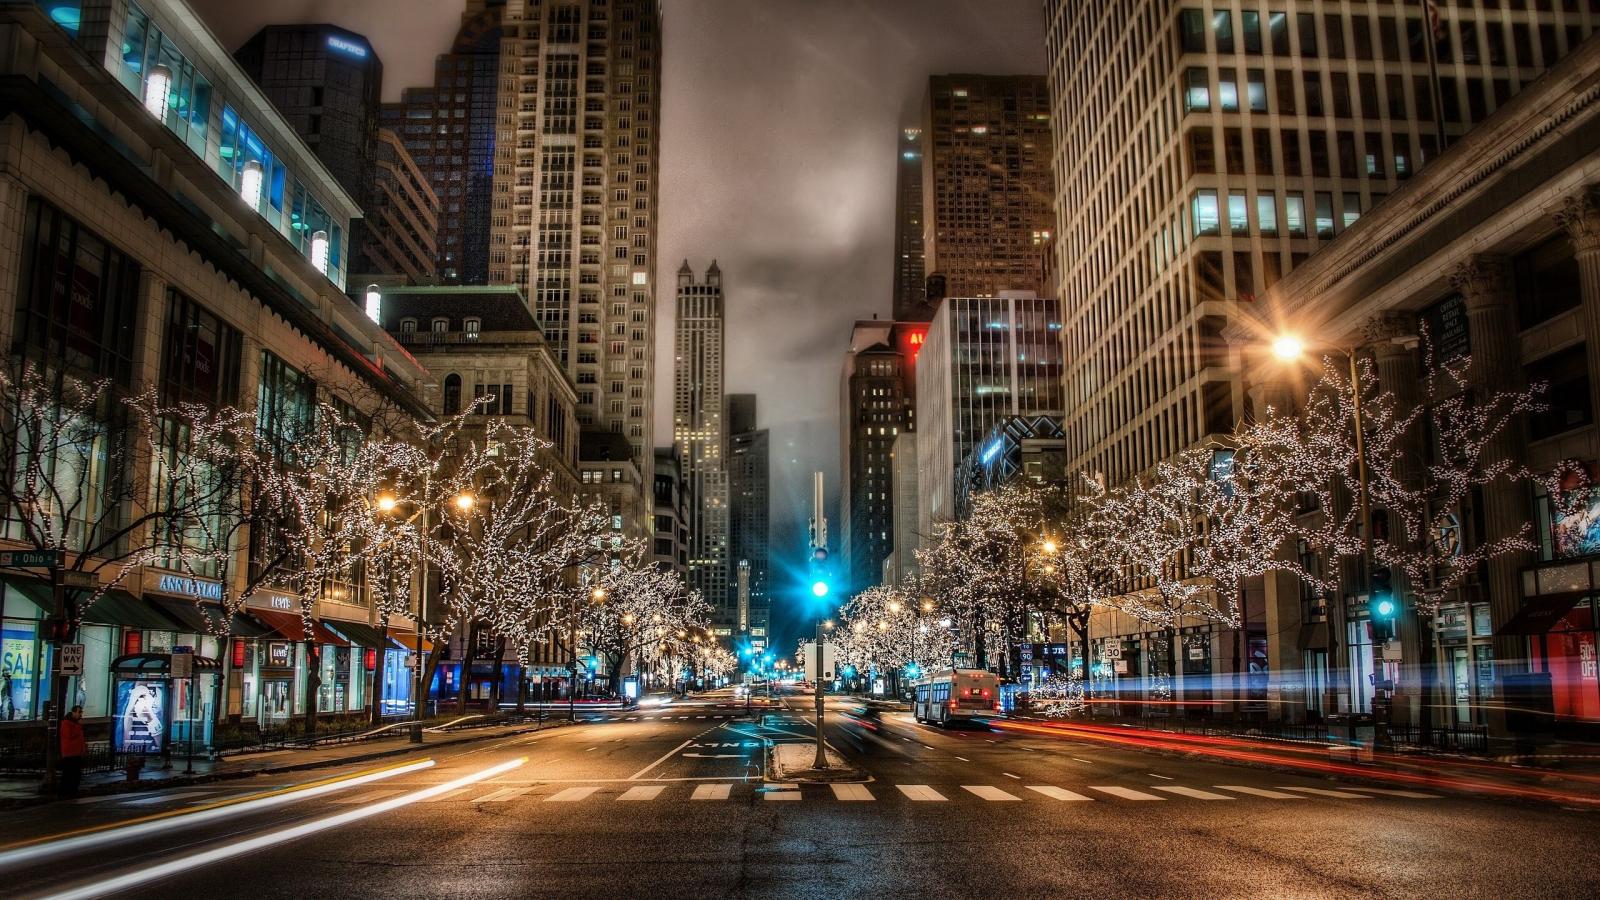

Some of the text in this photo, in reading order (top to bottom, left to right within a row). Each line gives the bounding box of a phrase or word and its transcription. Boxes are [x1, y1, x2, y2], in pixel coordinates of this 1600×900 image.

[23, 553, 44, 563] Ohio
[160, 575, 183, 592] ANN
[64, 647, 81, 655] ONE
[1107, 649, 1120, 657] 30
[63, 656, 81, 664] WAY
[1581, 661, 1597, 677] OFF
